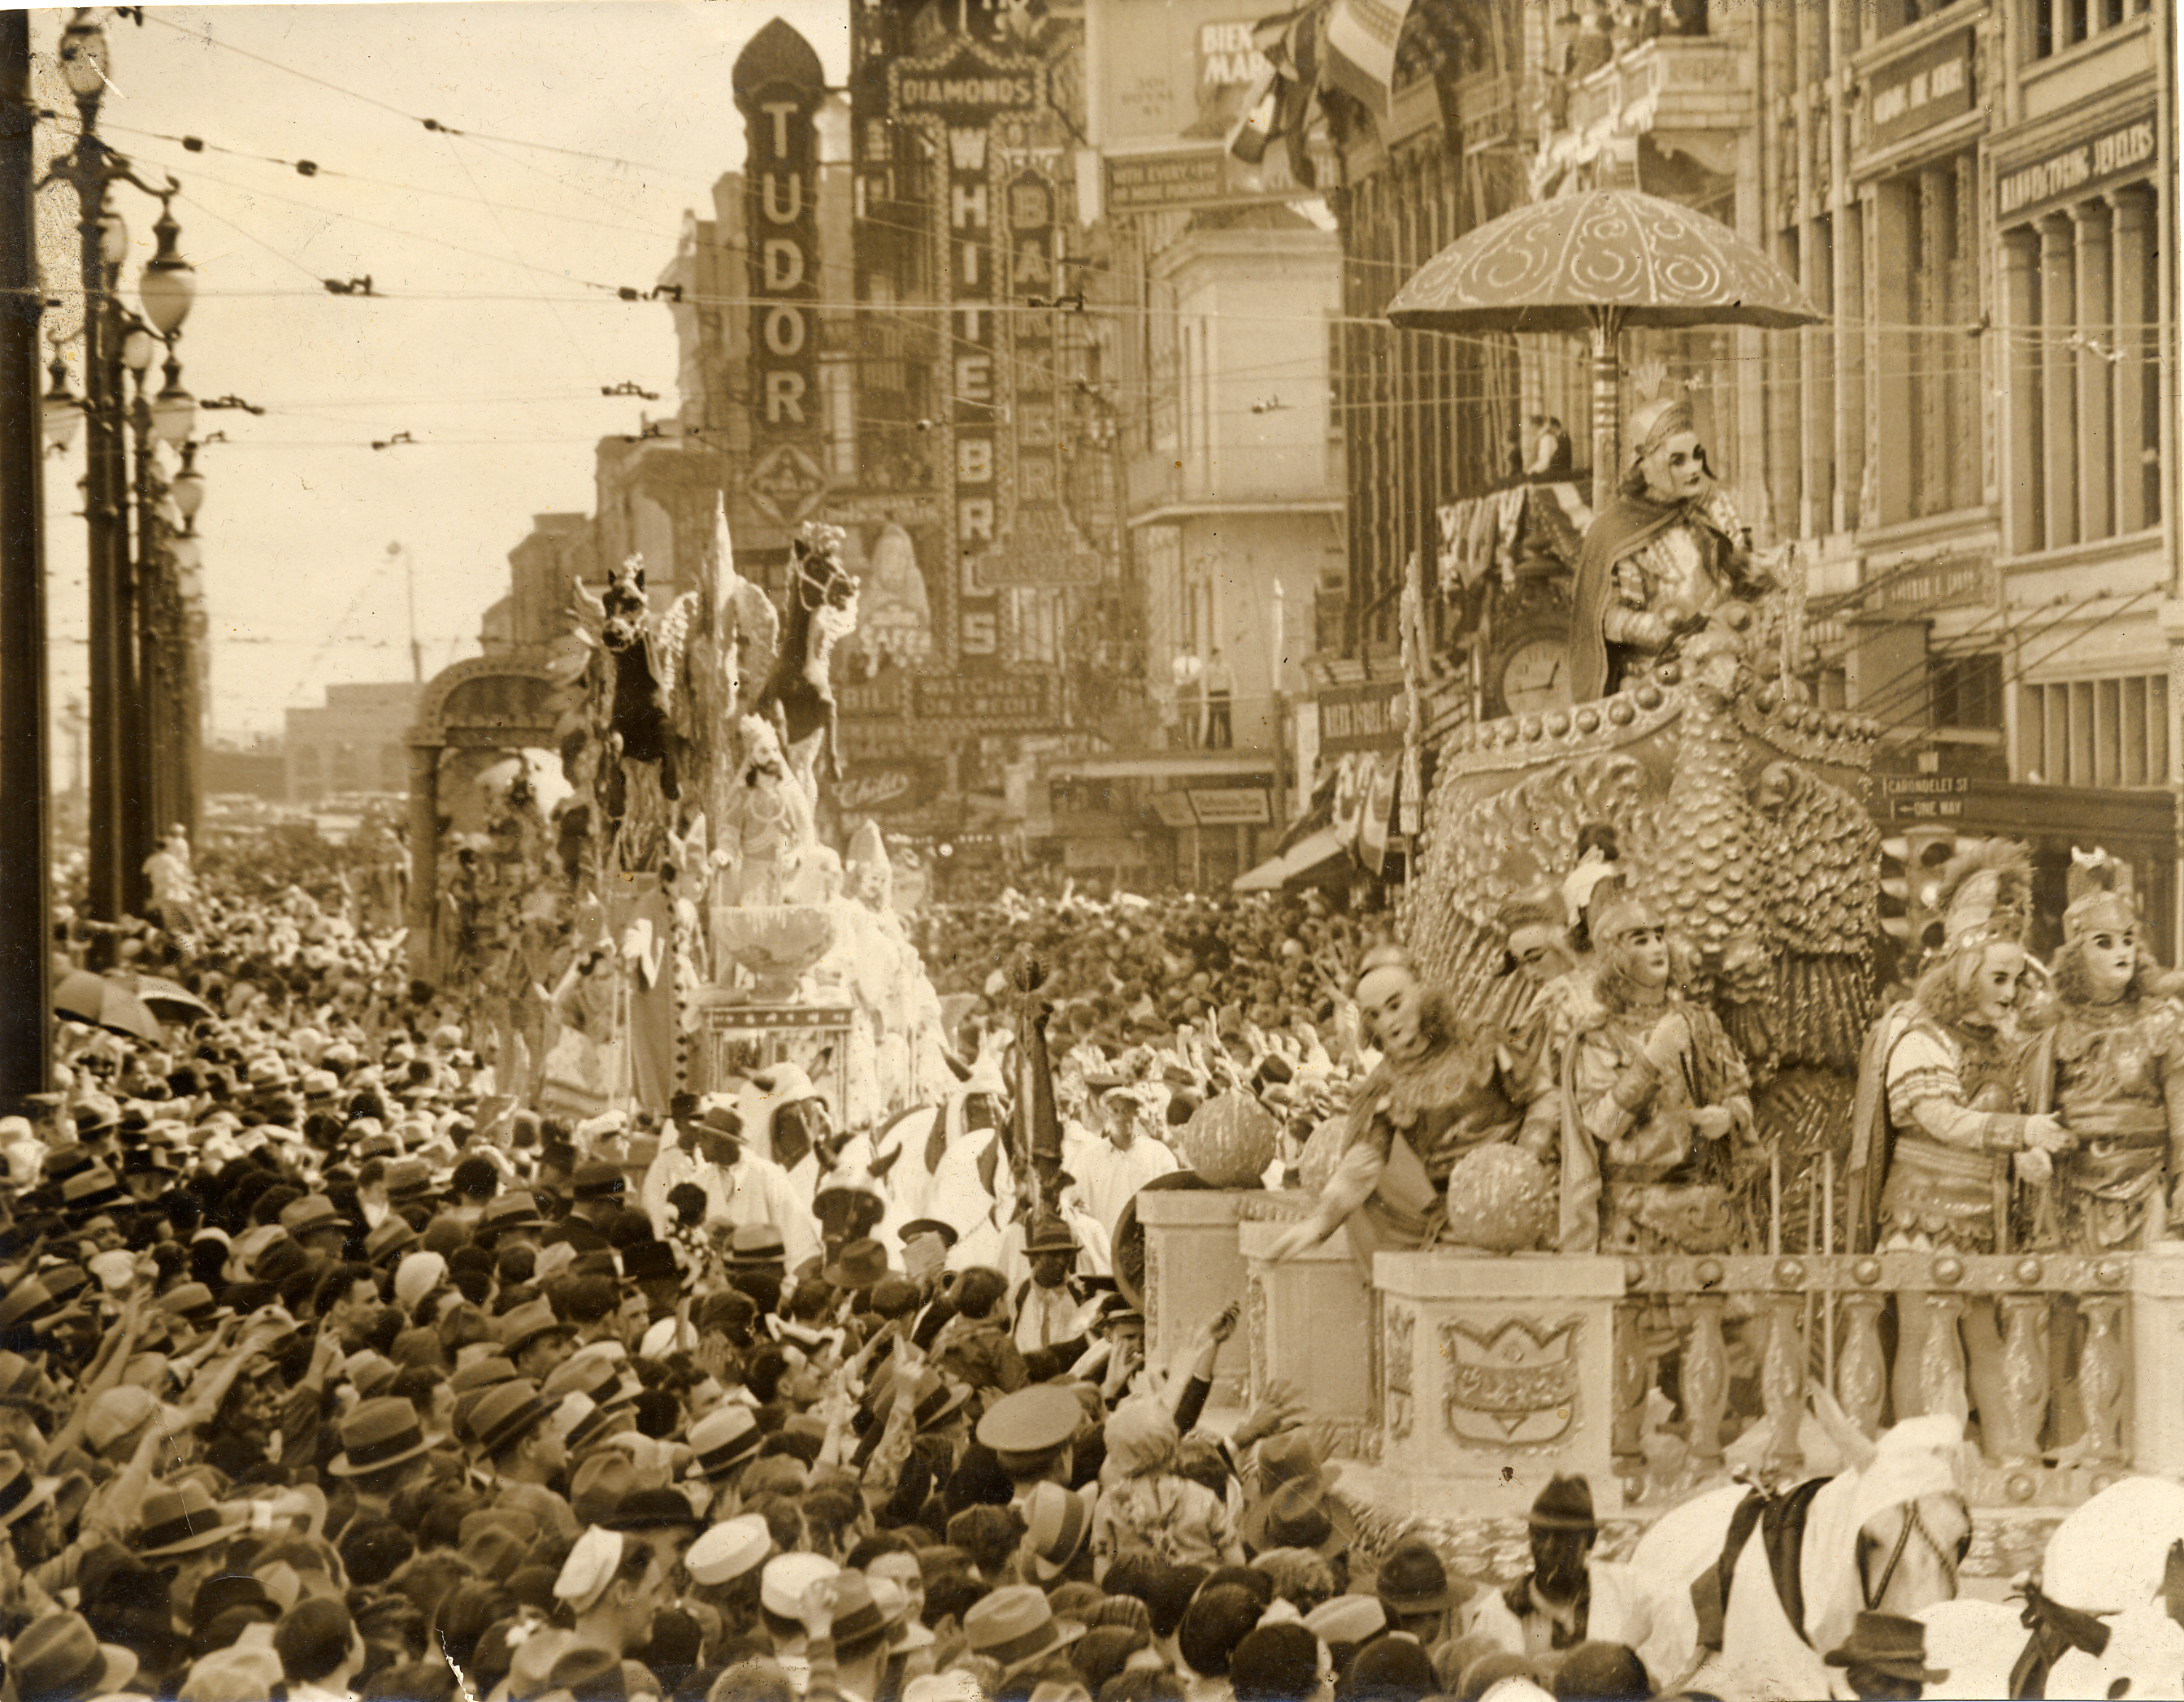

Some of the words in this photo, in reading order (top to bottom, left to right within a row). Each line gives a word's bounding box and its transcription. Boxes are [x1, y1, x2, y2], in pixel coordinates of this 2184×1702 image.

[901, 79, 1032, 104] DIAMONDS
[761, 102, 806, 423] TUDOR
[948, 128, 992, 399] WHITE
[1012, 185, 1057, 501] BARKER
[923, 677, 1040, 694] WATCHES
[921, 698, 952, 714] ON
[959, 697, 1038, 714] CREDIT
[1888, 777, 1953, 794] CARONDELET
[1914, 801, 1937, 816] ONE
[1939, 800, 1962, 816] WAY
